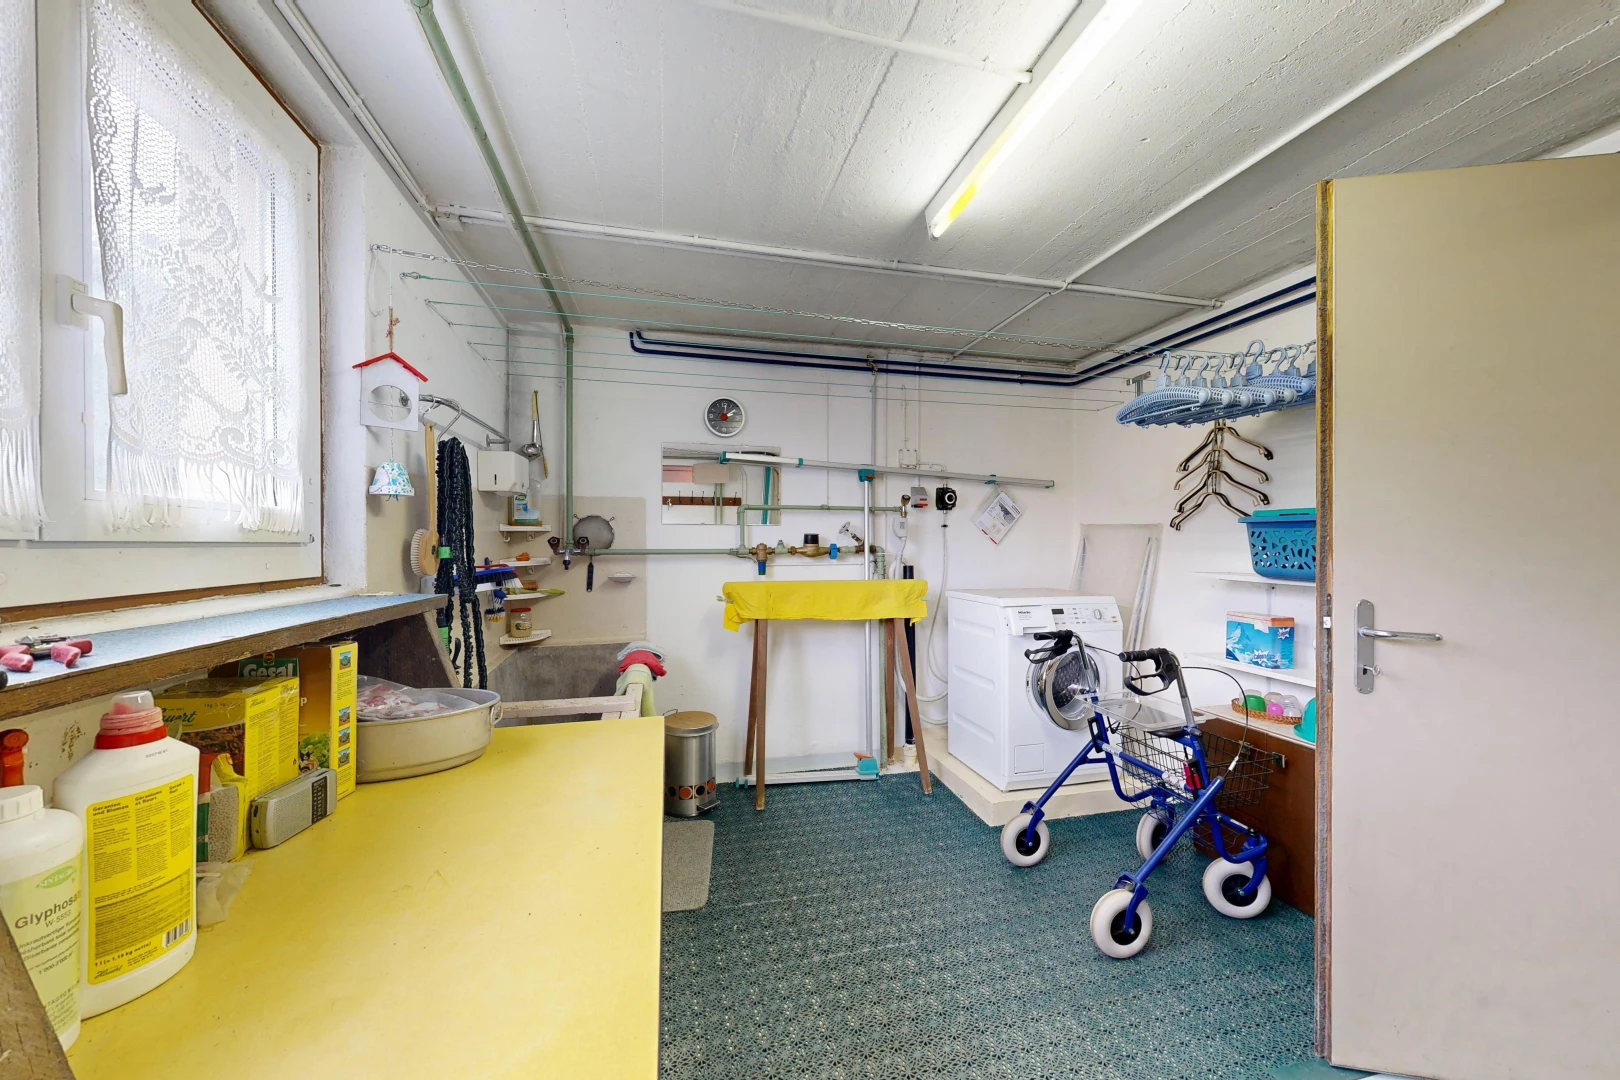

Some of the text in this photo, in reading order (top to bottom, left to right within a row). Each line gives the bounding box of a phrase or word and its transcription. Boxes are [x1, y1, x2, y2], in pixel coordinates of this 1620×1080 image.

[243, 663, 294, 678] Gesal
[162, 708, 197, 723] uert
[92, 802, 121, 812] Geranien
[106, 804, 129, 813] Blumen
